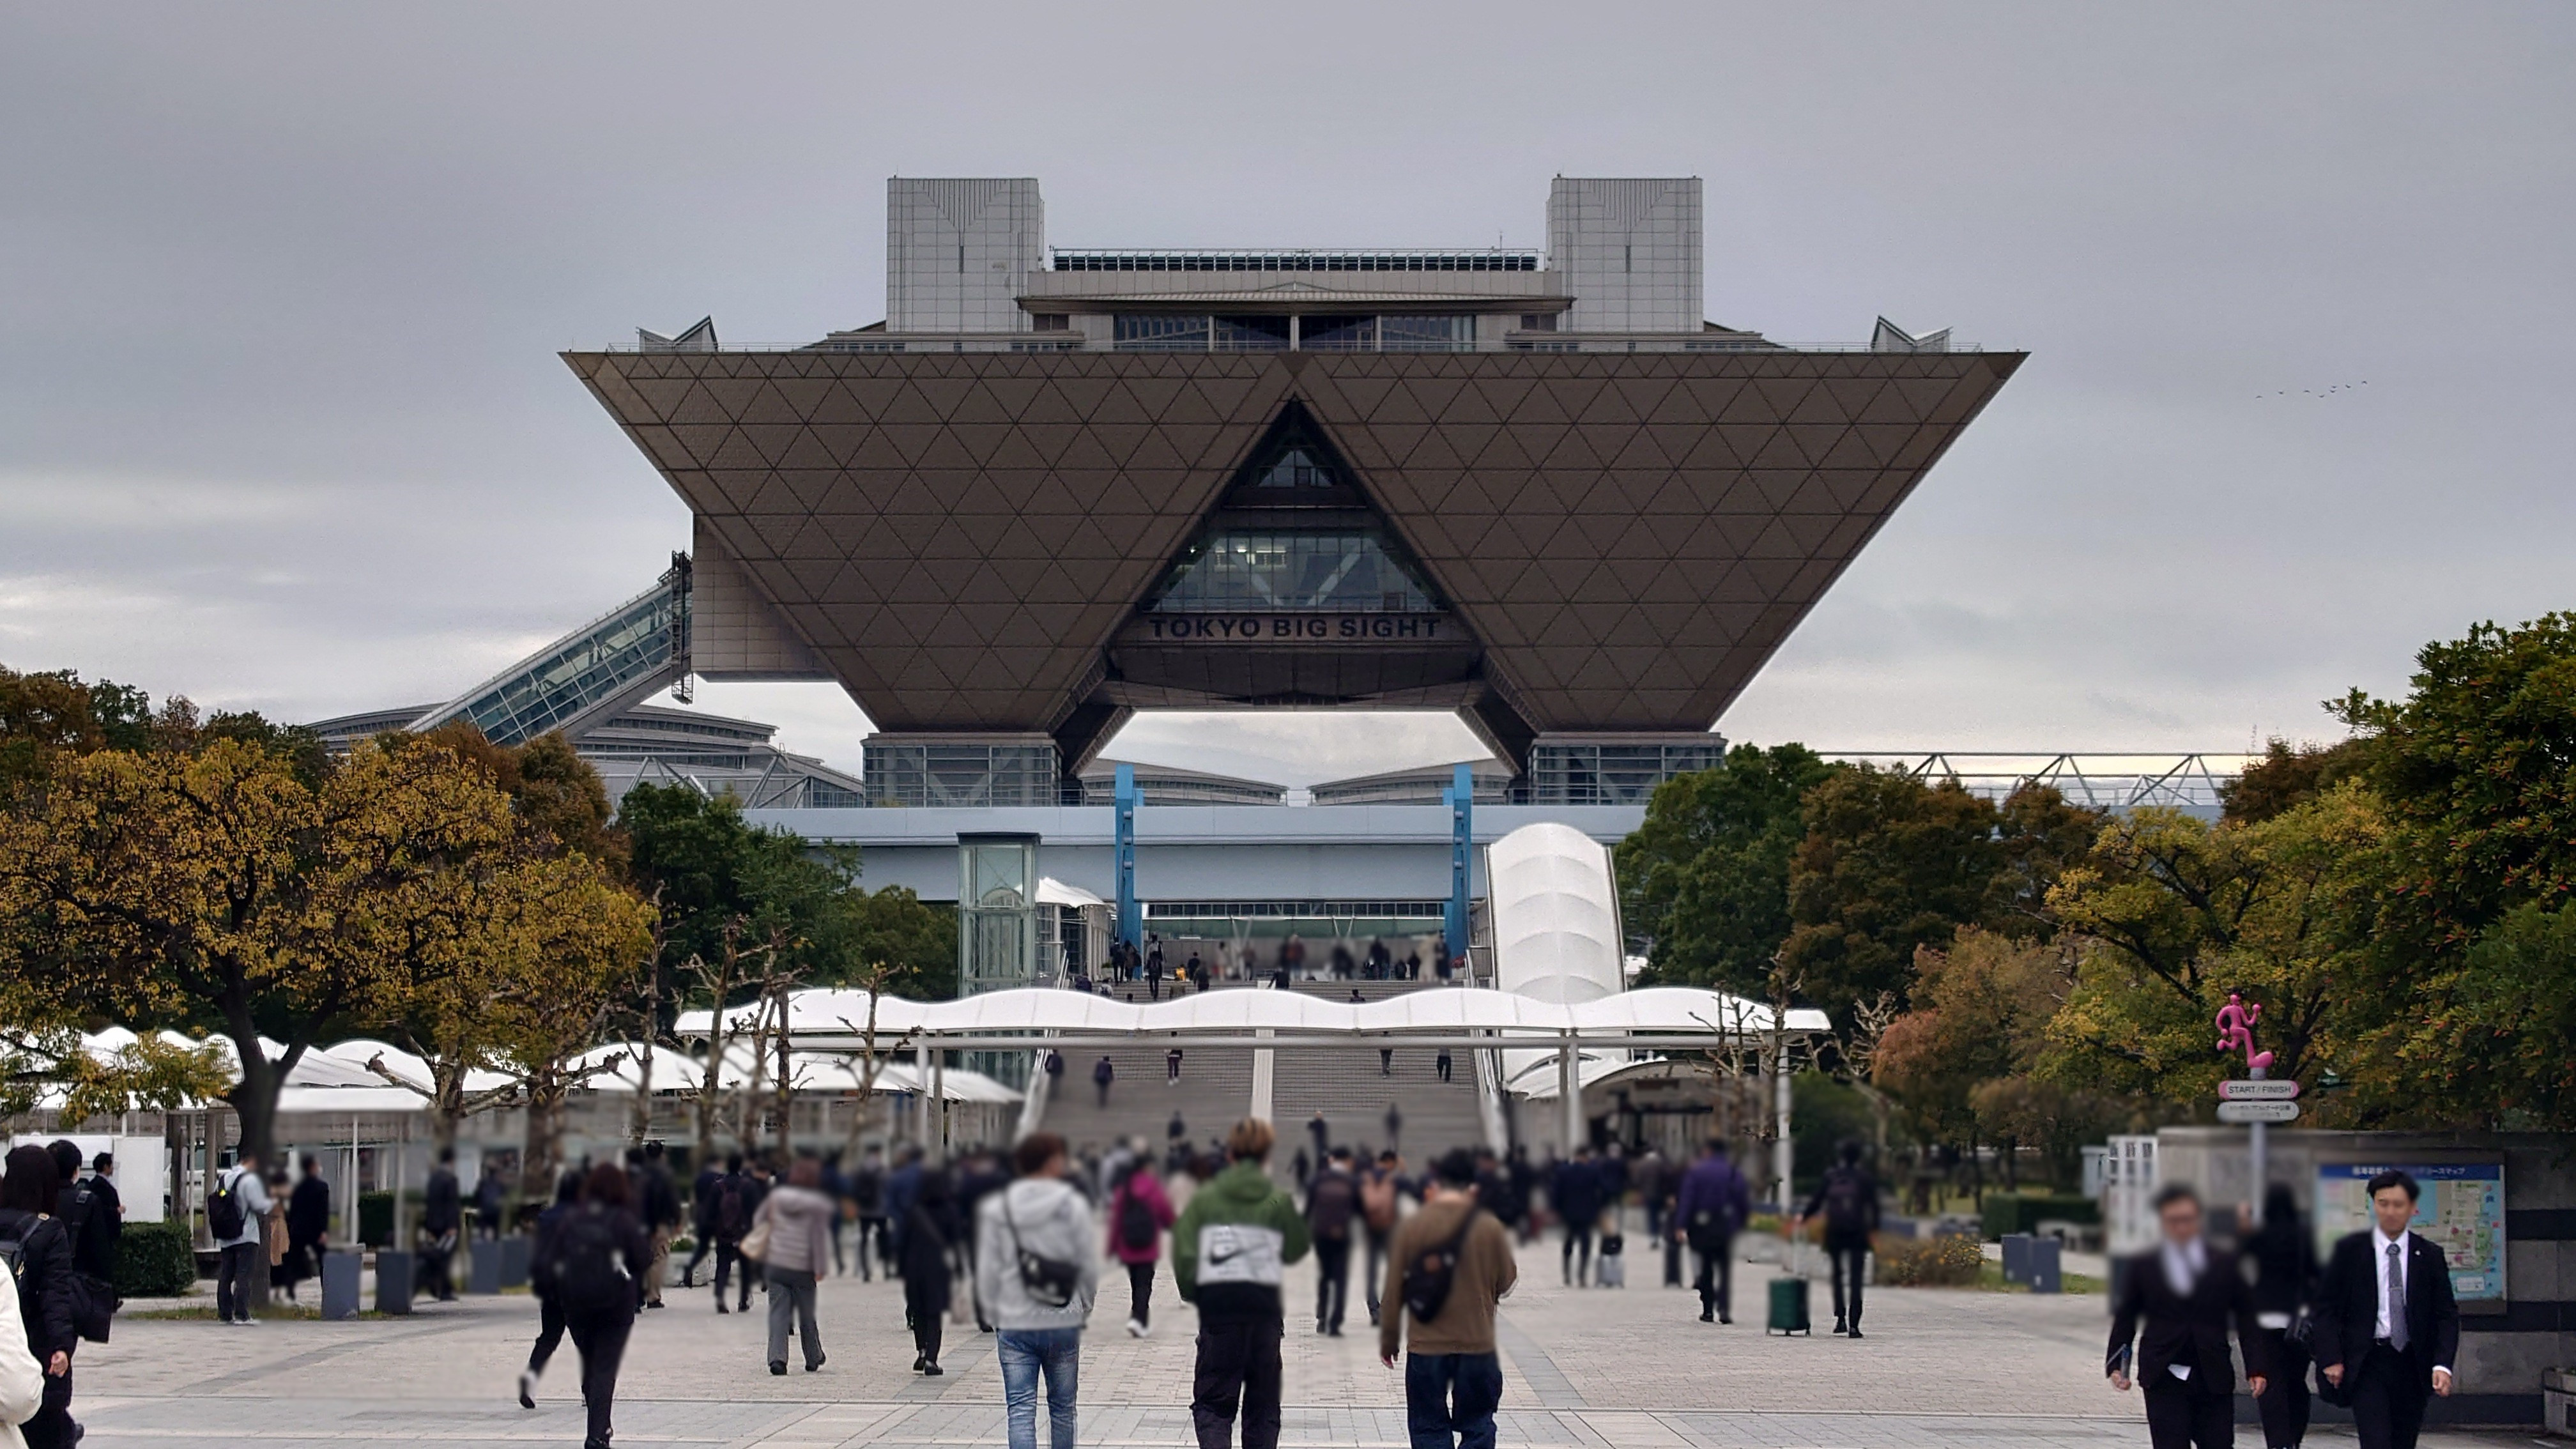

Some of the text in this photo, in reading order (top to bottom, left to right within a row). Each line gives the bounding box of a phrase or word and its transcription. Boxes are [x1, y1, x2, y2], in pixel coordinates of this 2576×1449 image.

[1151, 618, 1441, 638] TOKYO BIG SIGHT
